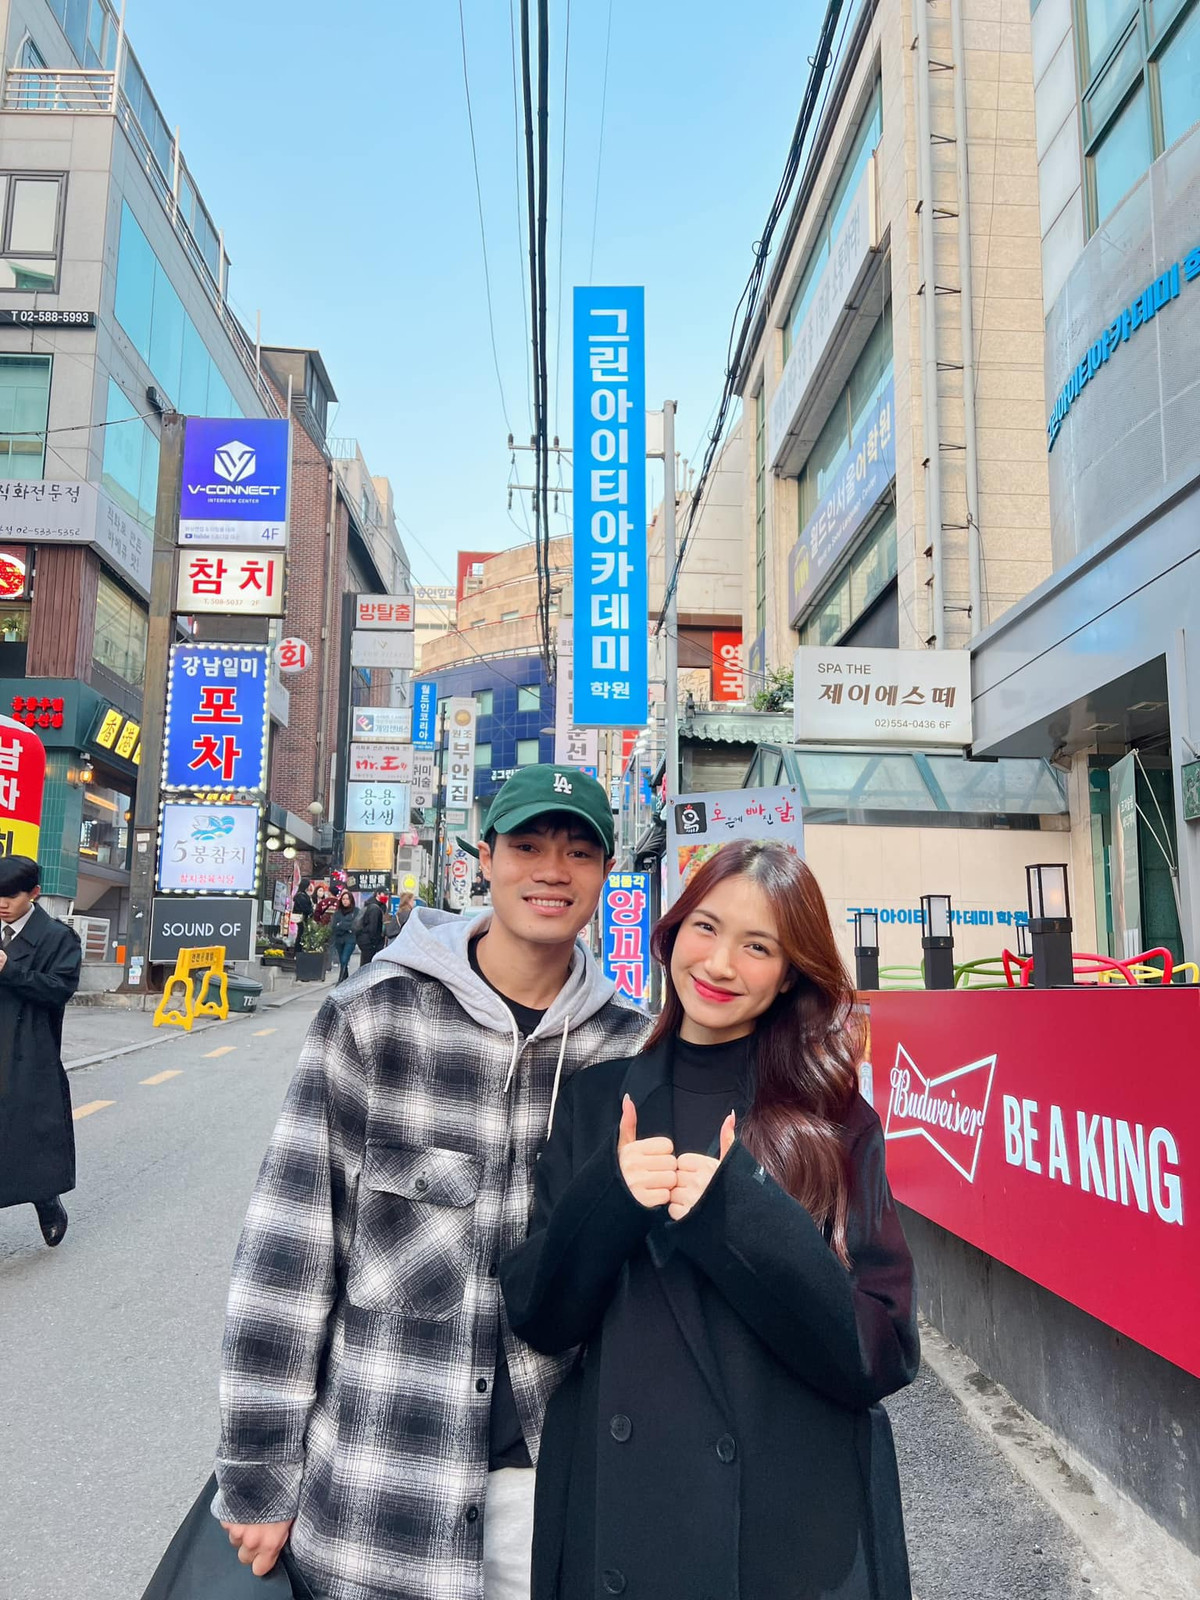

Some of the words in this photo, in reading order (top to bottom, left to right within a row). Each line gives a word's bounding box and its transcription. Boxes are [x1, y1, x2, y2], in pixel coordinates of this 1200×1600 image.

[11, 311, 18, 321] T
[20, 311, 89, 323] 02-588-5993
[188, 484, 281, 496] V-CONNECT
[588, 308, 634, 673] 그린아이티아카데미
[261, 528, 280, 541] 4F
[188, 558, 275, 597] 참치
[359, 603, 411, 622] 방탈출
[279, 640, 305, 668] 회
[181, 656, 258, 678] 강남일미
[817, 663, 842, 675] SPA
[846, 664, 871, 675] THE
[590, 681, 630, 699] 학원
[818, 682, 957, 708] 제이에스떼
[418, 683, 431, 741] 월드인코리아
[187, 685, 243, 781] 포차
[874, 718, 936, 730] 02)554-0436
[939, 720, 952, 730] 6F
[451, 742, 470, 803] 부안집
[553, 773, 573, 795] LA
[360, 808, 394, 826] 선생
[162, 922, 214, 937] SOUND
[219, 922, 241, 937] OF
[607, 889, 646, 998] 양꼬치
[890, 1066, 985, 1138] Budweiser
[1003, 1094, 1042, 1175] BE
[1049, 1104, 1071, 1185] A
[1077, 1110, 1184, 1226] KING
